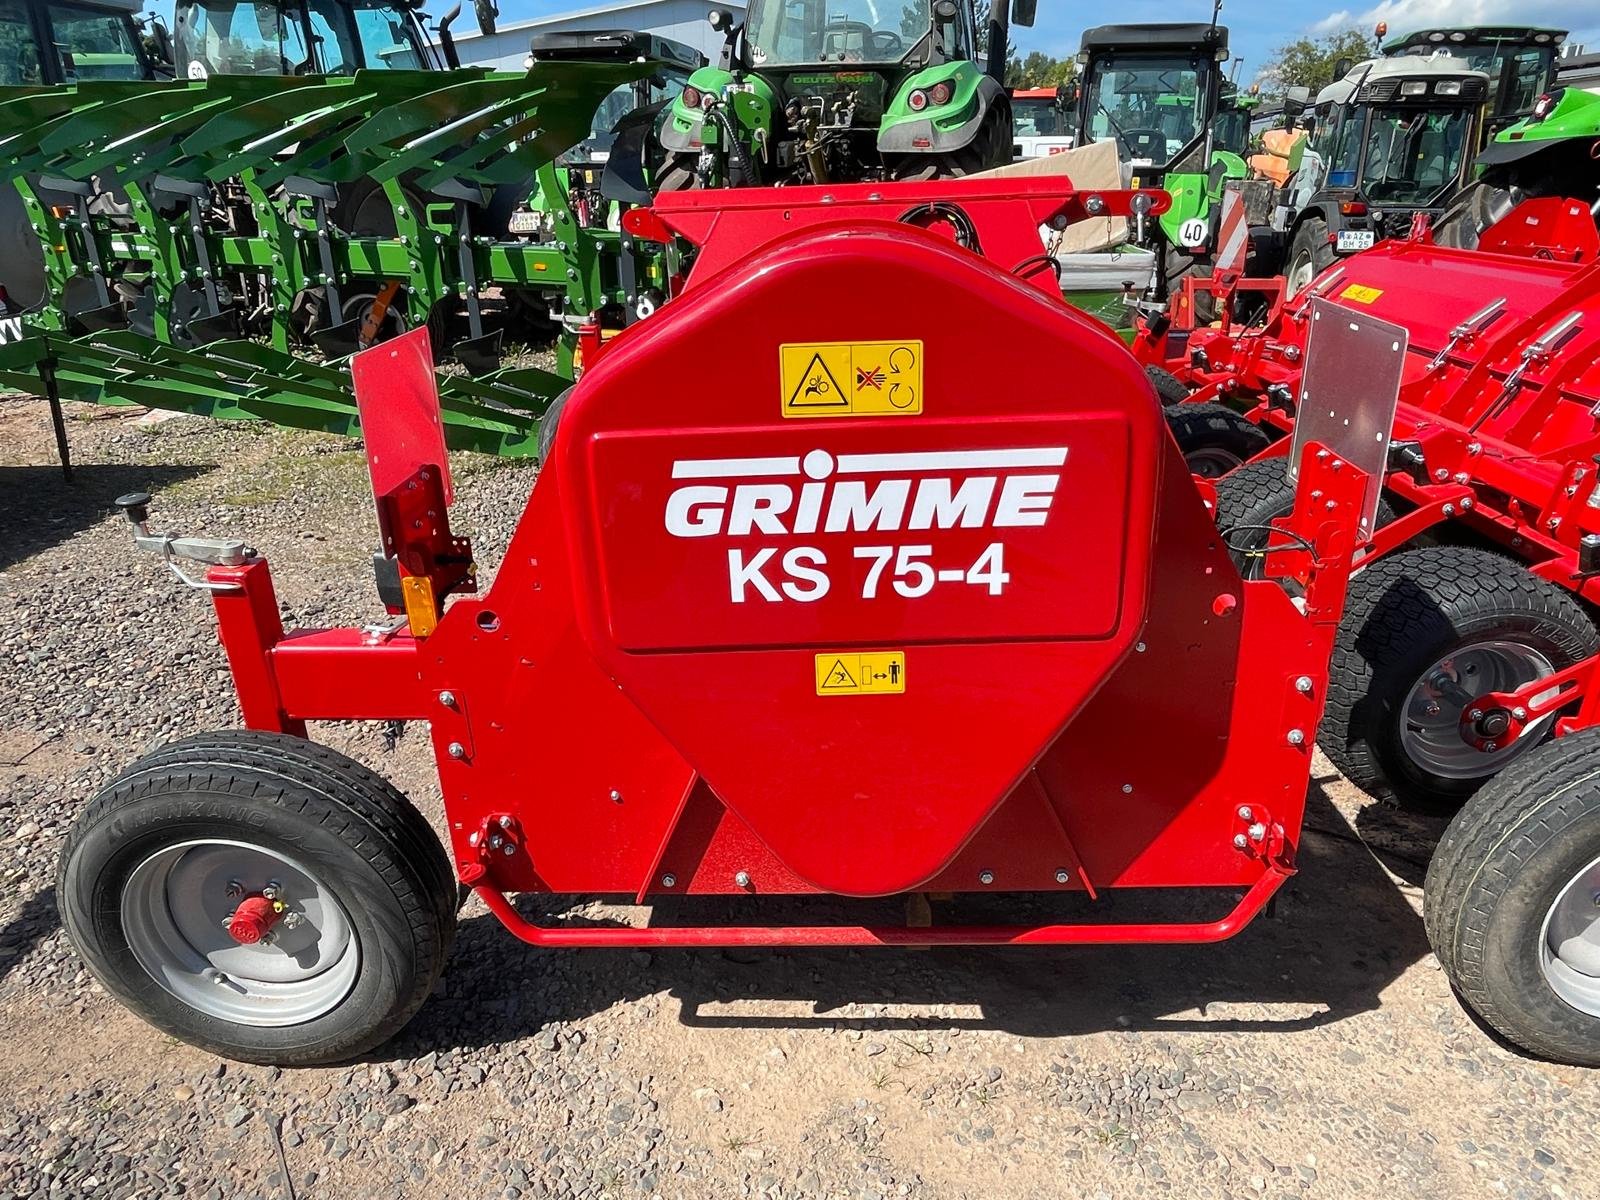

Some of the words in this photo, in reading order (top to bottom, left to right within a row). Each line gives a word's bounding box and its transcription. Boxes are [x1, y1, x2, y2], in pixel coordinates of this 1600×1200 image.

[793, 76, 834, 84] DEUTZ
[1184, 223, 1202, 241] 40
[1353, 232, 1364, 240] AZ
[664, 449, 1061, 538] GRIMME
[727, 546, 831, 603] KS
[853, 543, 1010, 599] 75-4
[135, 801, 270, 827] NANKANG
